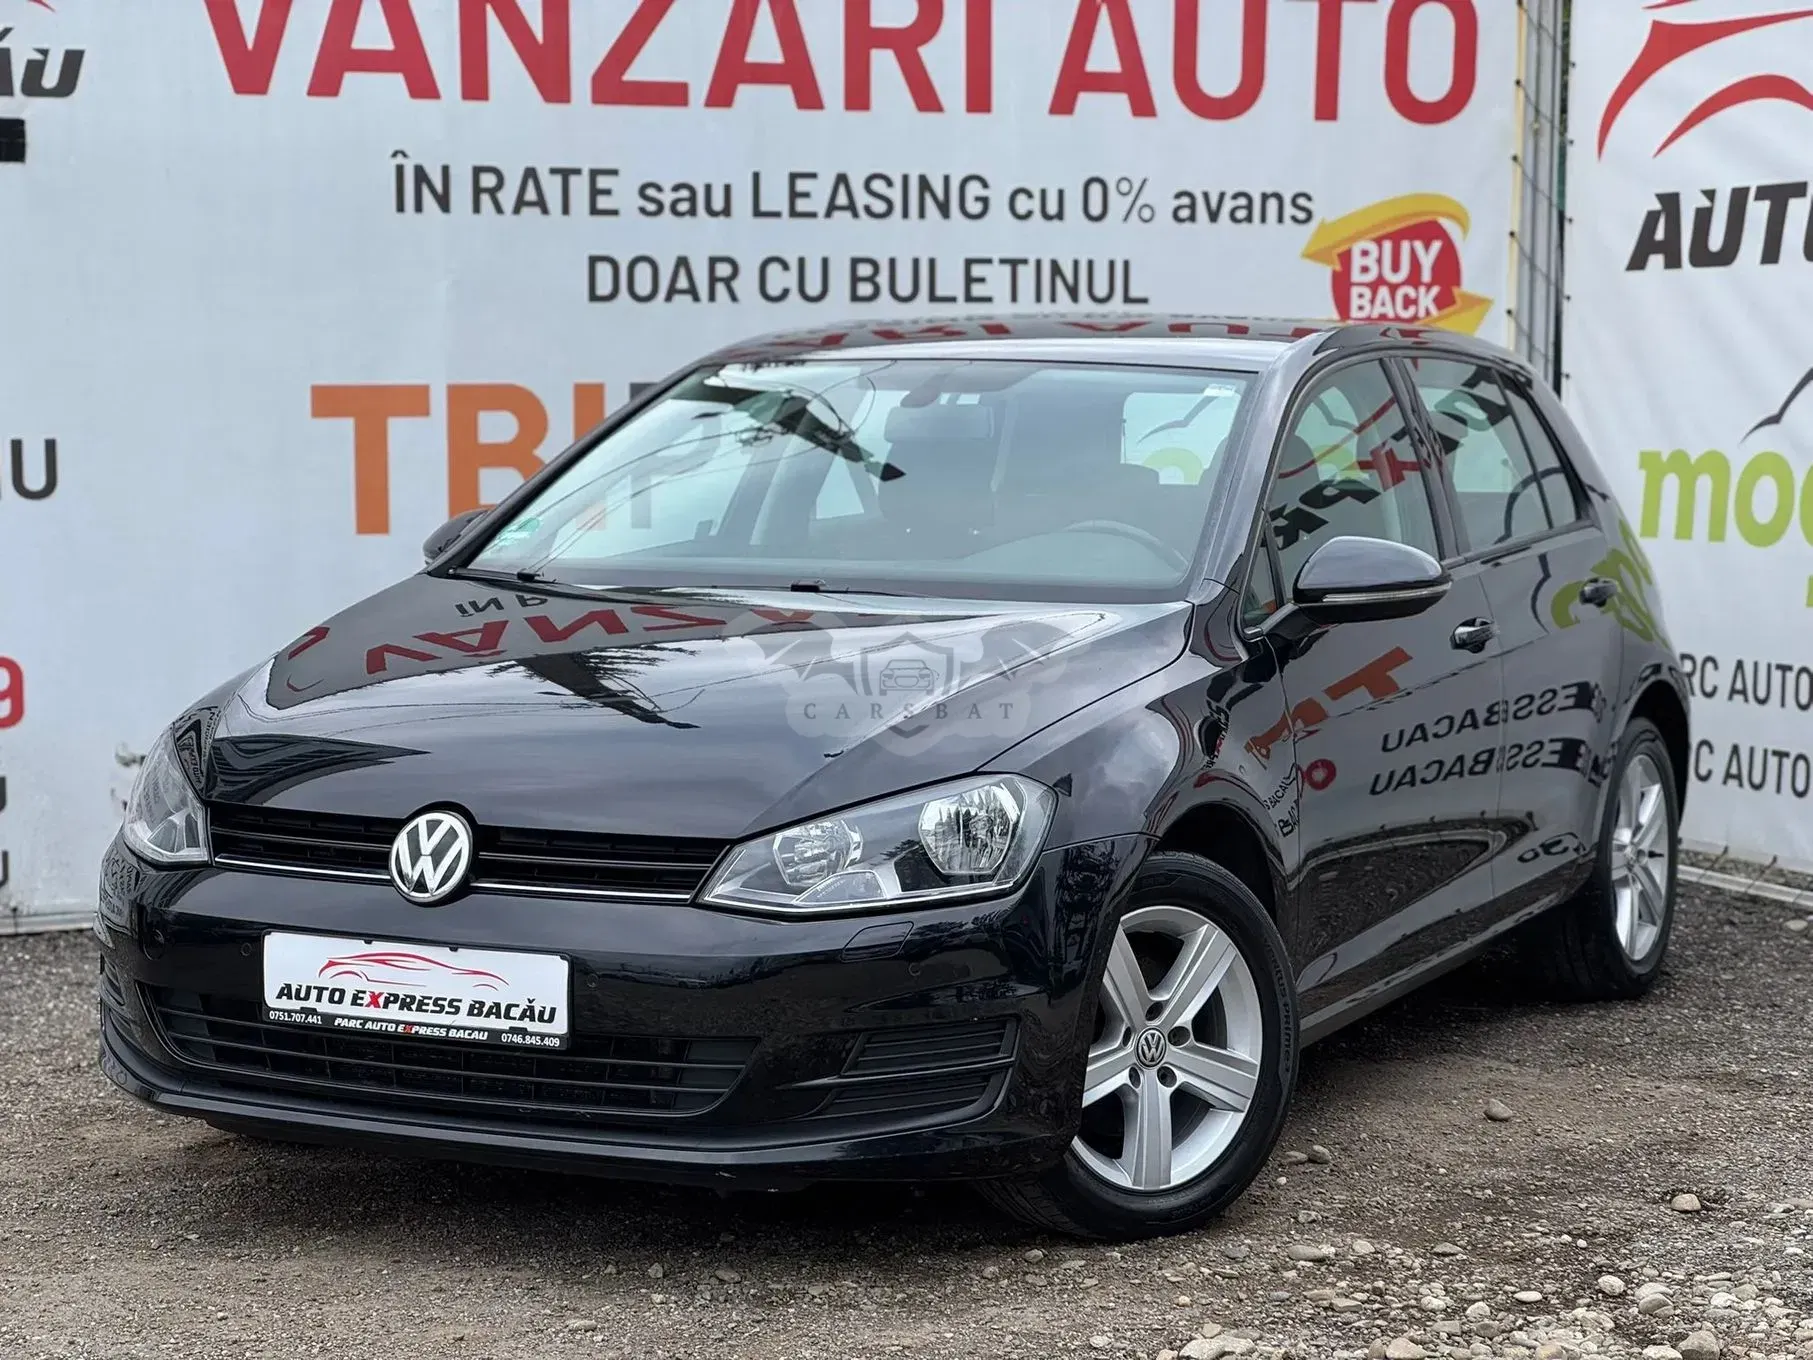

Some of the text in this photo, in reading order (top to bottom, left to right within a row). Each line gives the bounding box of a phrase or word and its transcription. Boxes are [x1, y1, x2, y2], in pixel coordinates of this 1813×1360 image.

[1050, 0, 1478, 124] AUTO
[391, 149, 1313, 225] ÎN RATE sau LEASING cu 0% avans
[1625, 181, 1813, 271] AUT
[588, 255, 1149, 305] DOAR CU BULETINUL
[1351, 240, 1442, 283] BUY
[1351, 285, 1441, 319] BACK
[1727, 659, 1813, 712] AUTO
[1721, 743, 1812, 799] AUTO
[269, 1010, 322, 1025] 0751.707.441
[276, 983, 346, 1005] AUTO
[351, 989, 463, 1015] EXPRESS
[334, 1017, 489, 1040] PARC AUTO EXPRESS BACAU
[501, 1033, 560, 1047] 0746.845.409
